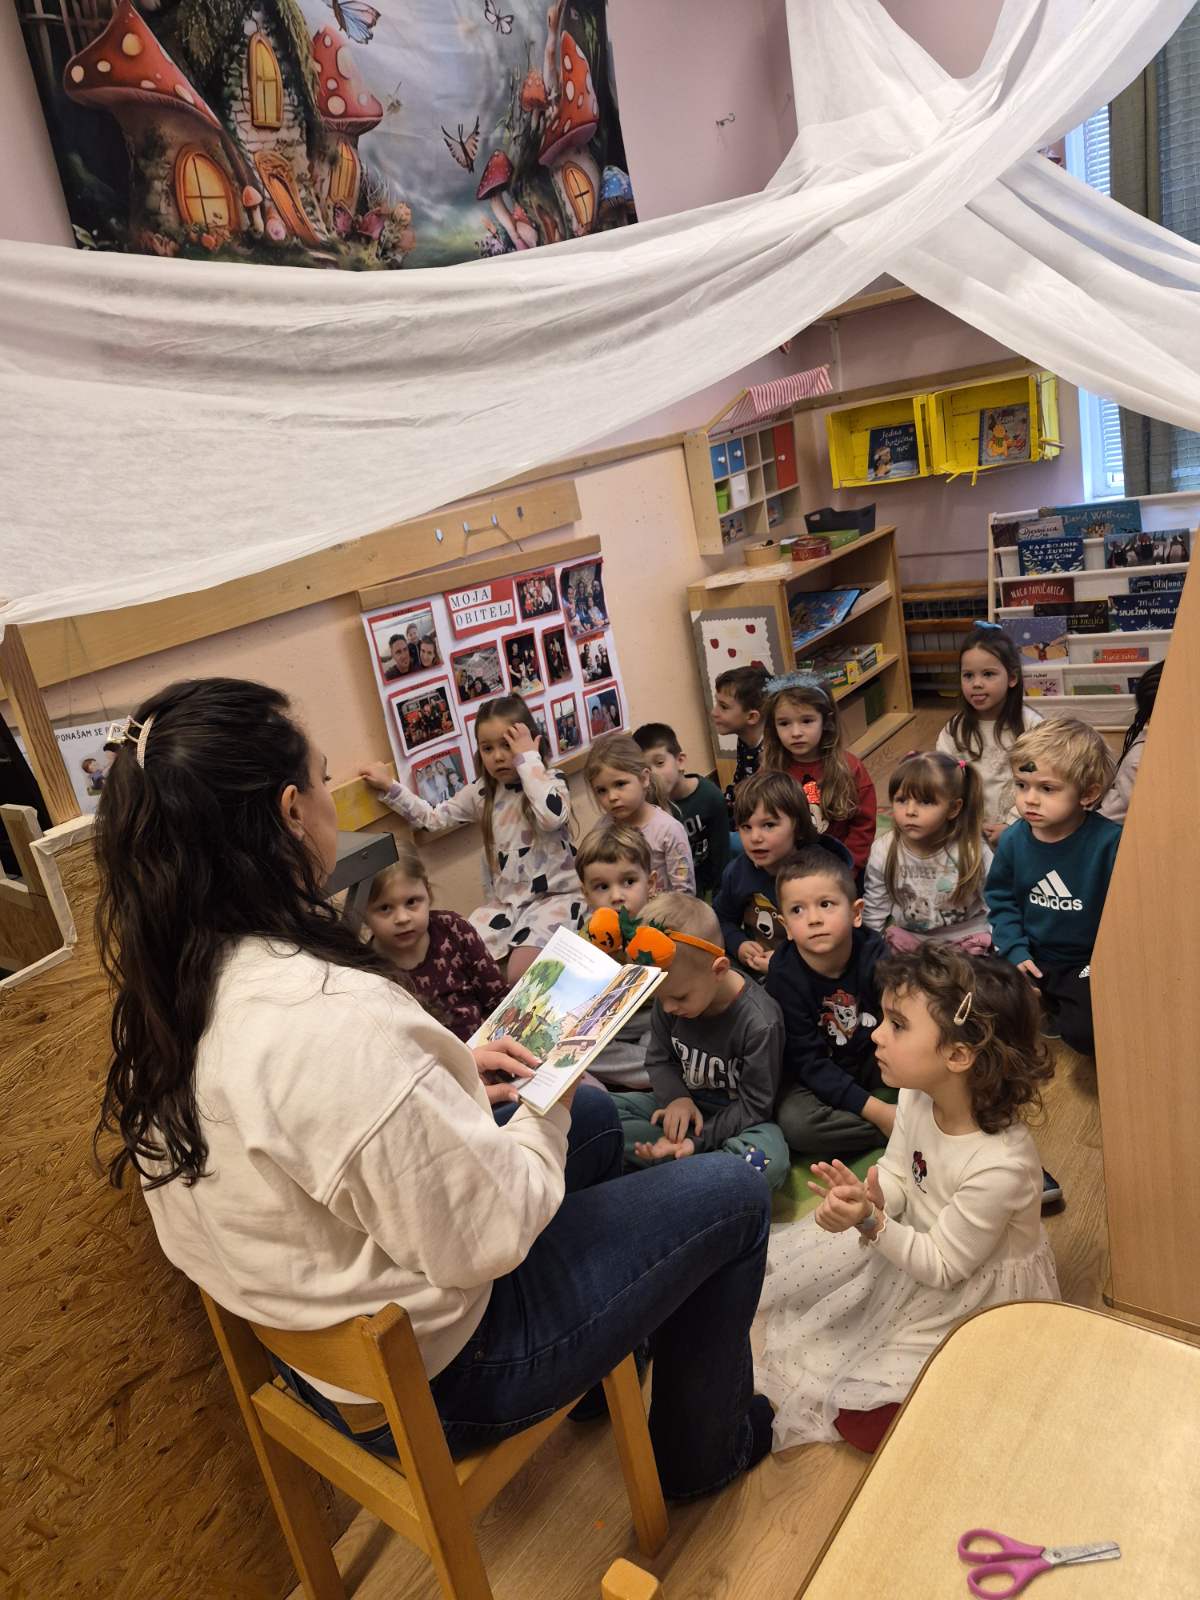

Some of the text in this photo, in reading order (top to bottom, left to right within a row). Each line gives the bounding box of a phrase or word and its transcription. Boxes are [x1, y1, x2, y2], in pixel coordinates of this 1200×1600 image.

[450, 588, 489, 609] MOJA
[456, 603, 511, 626] OBITELJ
[1119, 607, 1148, 617] SNJEŽNA
[56, 729, 92, 742] PONAŠAM
[94, 728, 104, 737] SE
[1029, 893, 1083, 911] adidas
